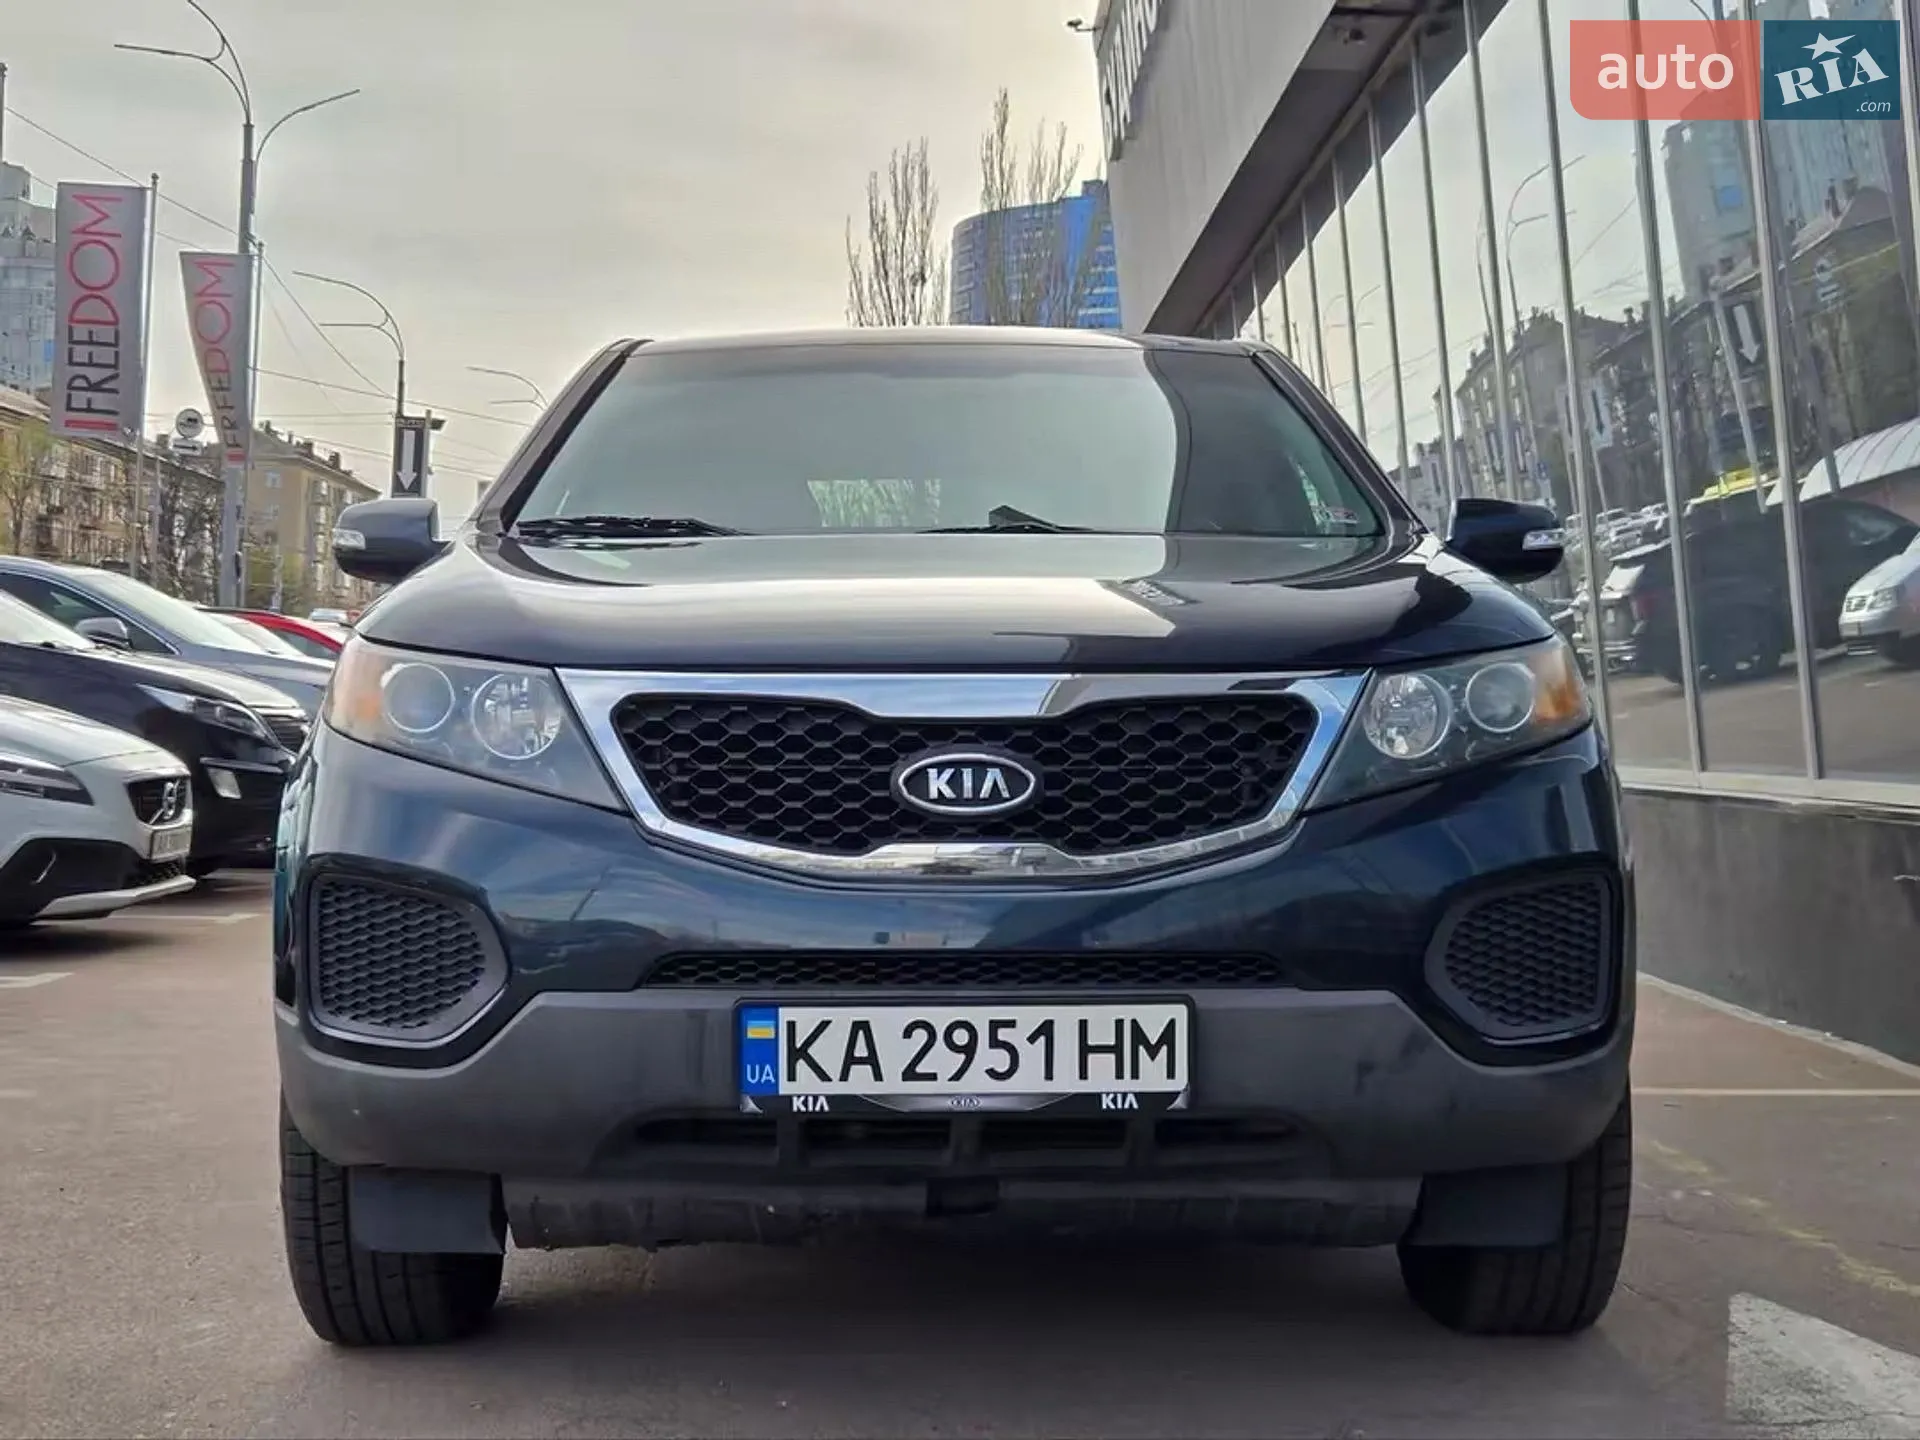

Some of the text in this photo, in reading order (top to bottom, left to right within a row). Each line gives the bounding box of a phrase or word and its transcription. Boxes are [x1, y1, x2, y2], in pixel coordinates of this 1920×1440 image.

[927, 768, 1010, 799] KIA
[785, 1018, 1177, 1083] KA 2951 HM
[746, 1065, 776, 1084] UA
[792, 1096, 829, 1112] KIA
[1101, 1093, 1139, 1110] KIA
